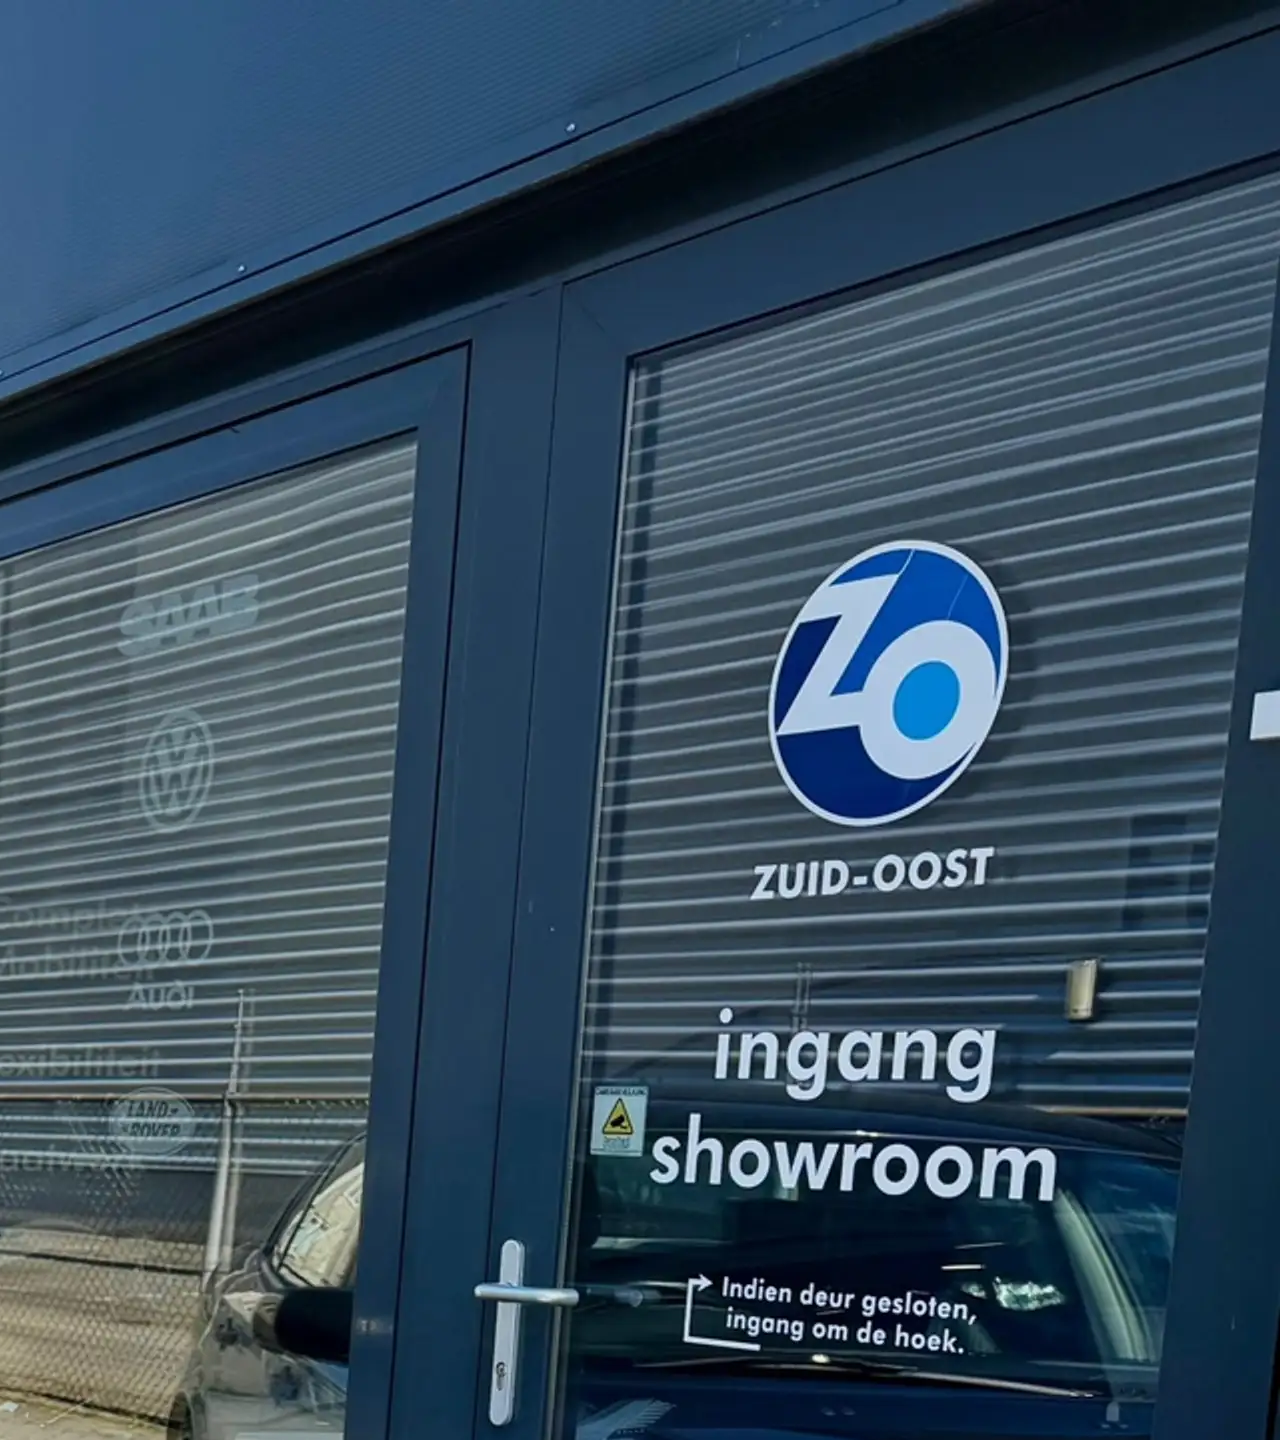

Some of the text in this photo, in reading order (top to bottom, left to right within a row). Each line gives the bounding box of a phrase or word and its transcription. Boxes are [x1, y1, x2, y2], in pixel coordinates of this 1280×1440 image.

[118, 573, 260, 656] SAAB
[750, 846, 995, 901] ZUID-OOST
[713, 1007, 998, 1104] ingang
[649, 1113, 1057, 1202] showroom
[721, 1275, 978, 1326] Indien deur gesloten,
[725, 1306, 965, 1354] ingang om de hoek.
